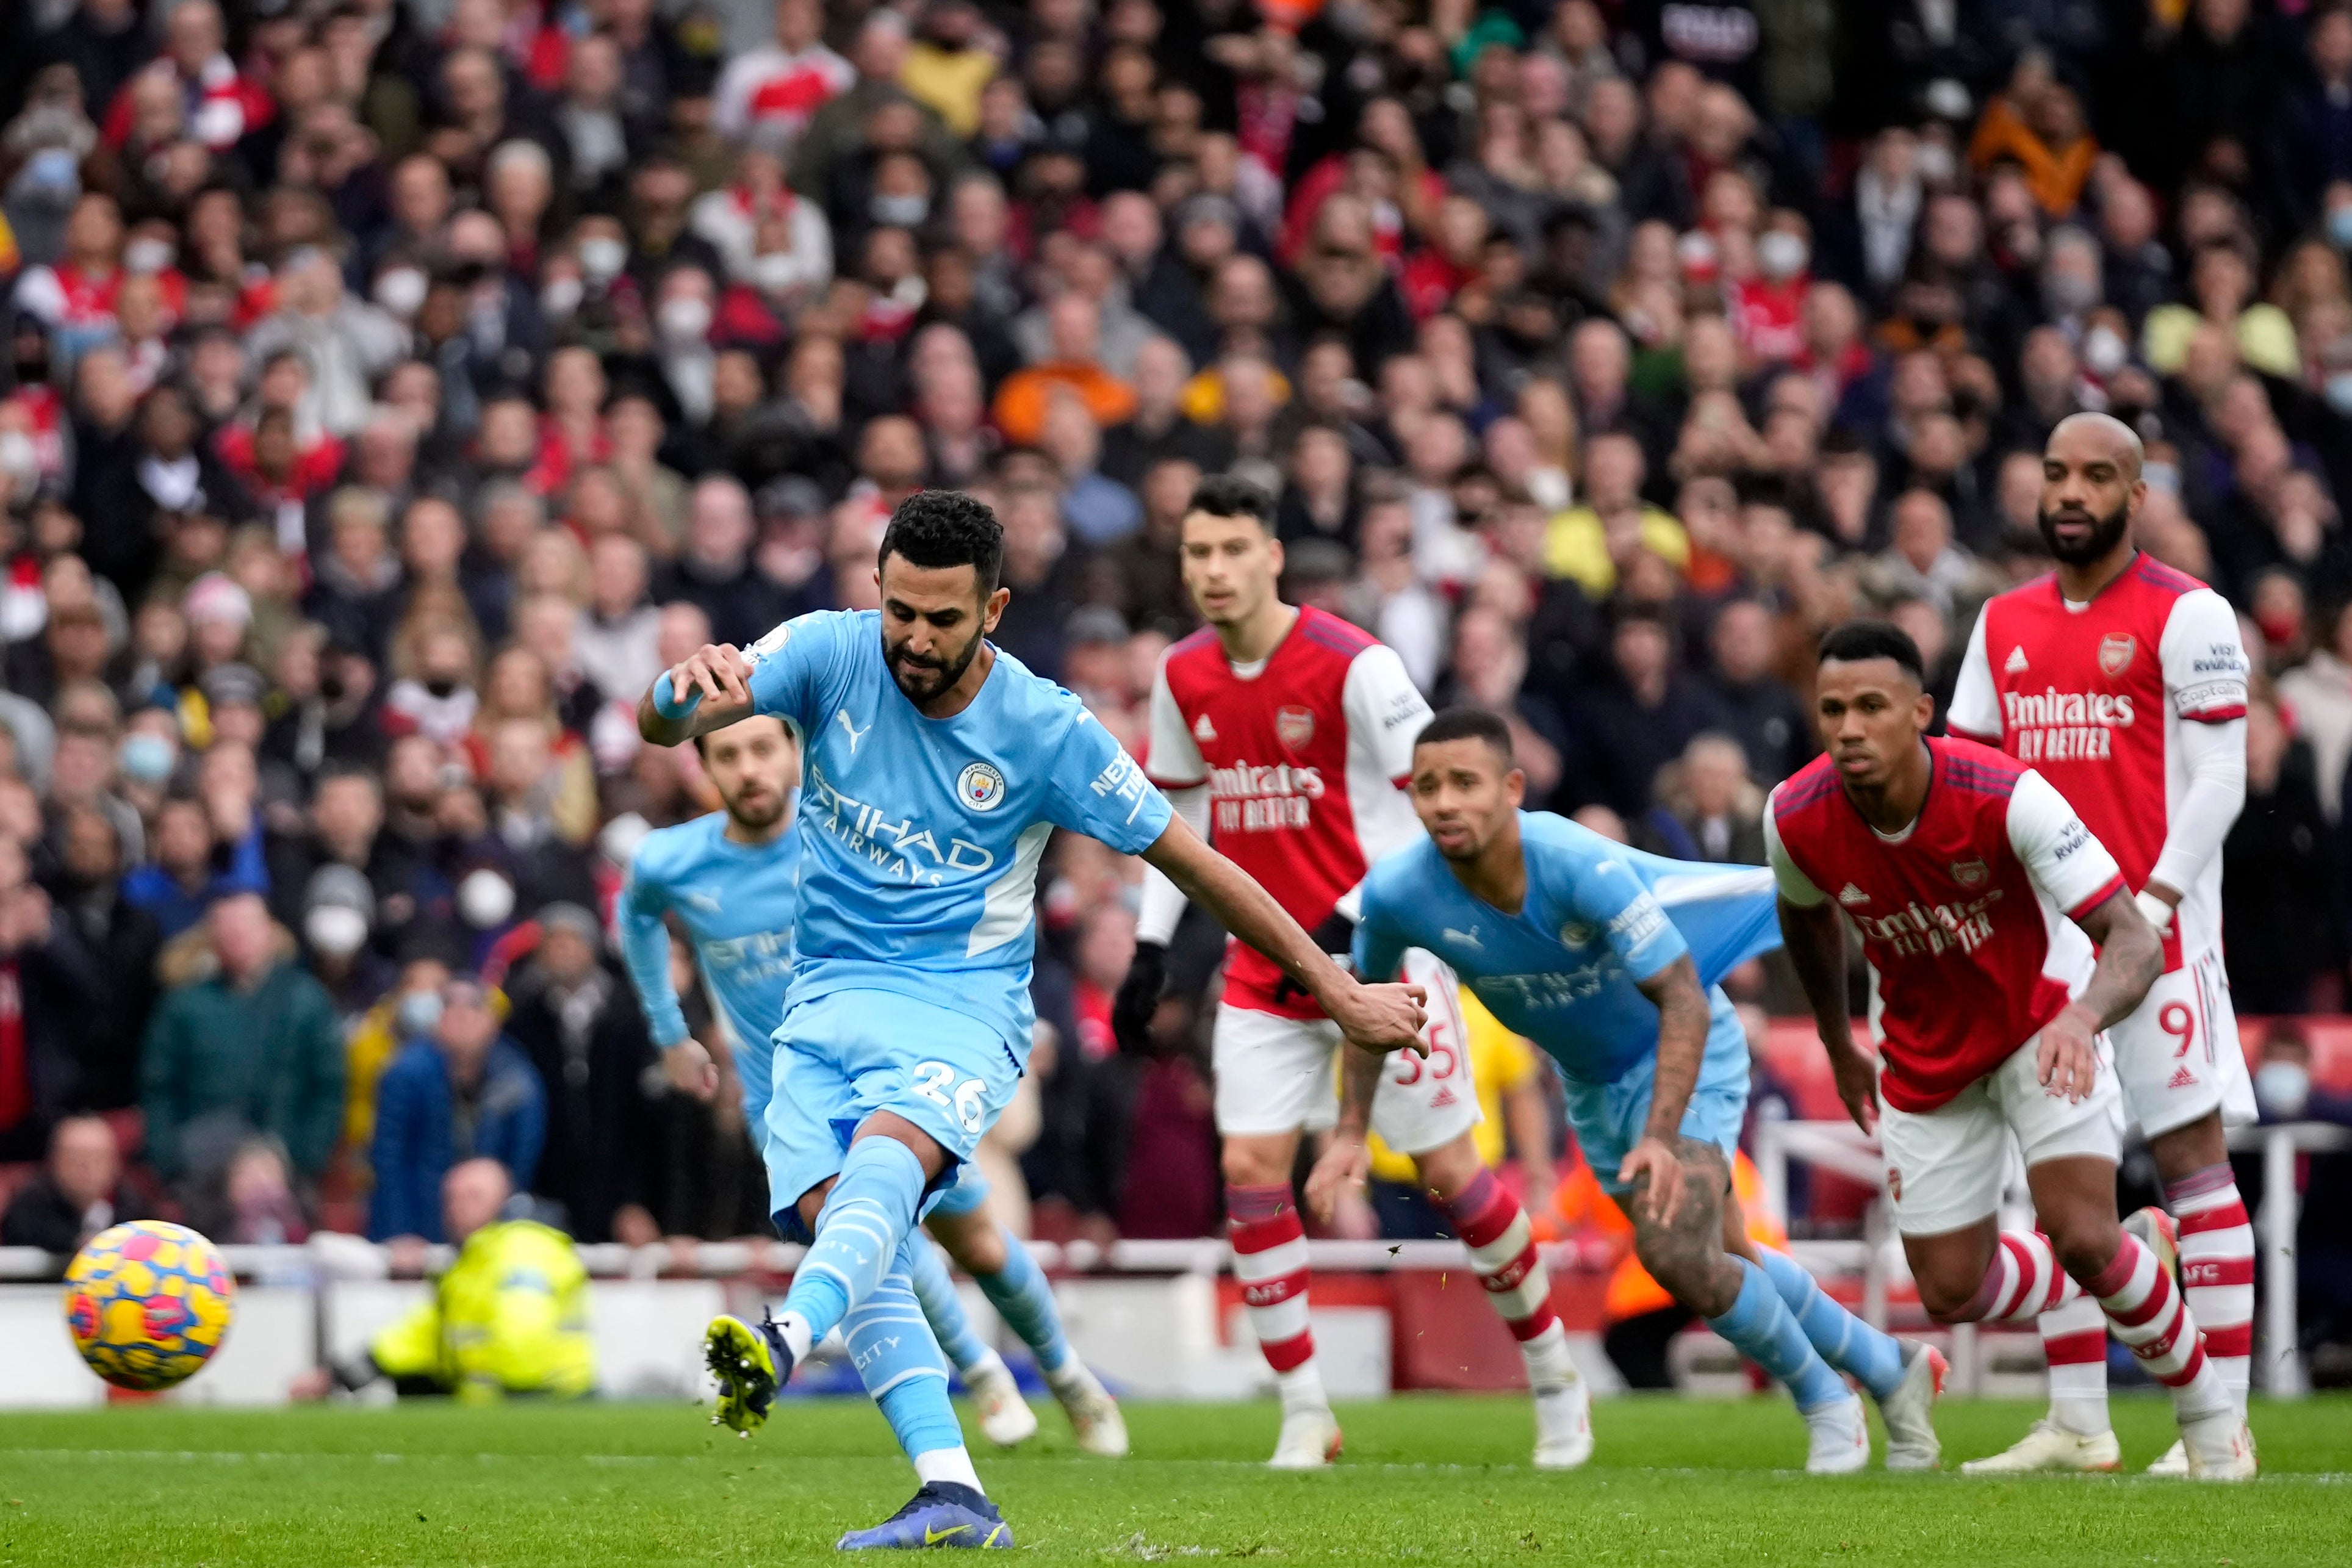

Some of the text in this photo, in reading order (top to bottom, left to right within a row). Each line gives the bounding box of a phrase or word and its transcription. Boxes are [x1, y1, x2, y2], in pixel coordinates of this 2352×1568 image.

[2179, 682, 2241, 704] Captain
[965, 764, 1003, 786] MANCHESTER
[812, 763, 994, 872] ETIHAD
[968, 800, 984, 809] CITY
[824, 814, 943, 887] AIRWAYS
[2160, 999, 2195, 1057] 9
[908, 1060, 988, 1134] 26
[855, 1336, 901, 1370] CITY
